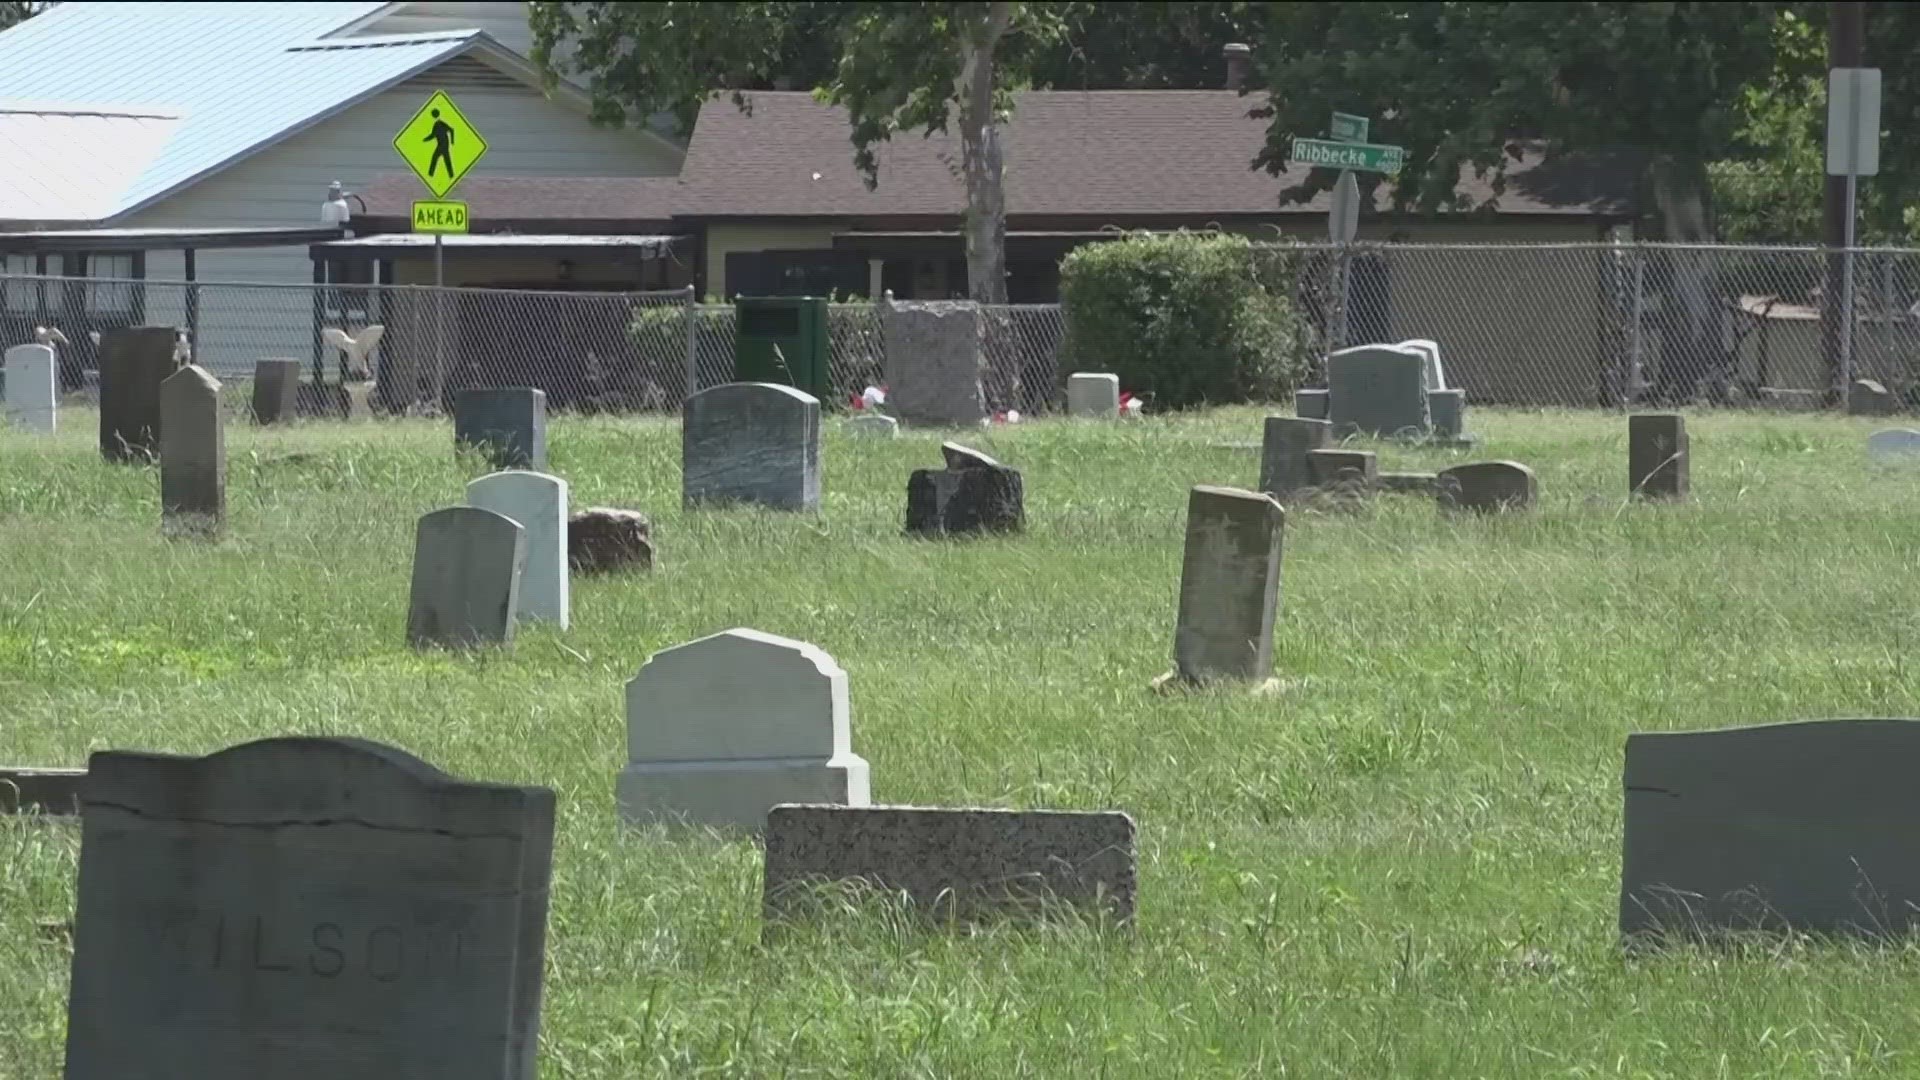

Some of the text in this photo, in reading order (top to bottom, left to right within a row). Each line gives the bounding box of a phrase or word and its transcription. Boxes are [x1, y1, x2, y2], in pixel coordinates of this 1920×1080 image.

[1296, 143, 1367, 166] Ribbecke
[1382, 150, 1399, 159] AVE
[416, 208, 464, 225] AHEAD
